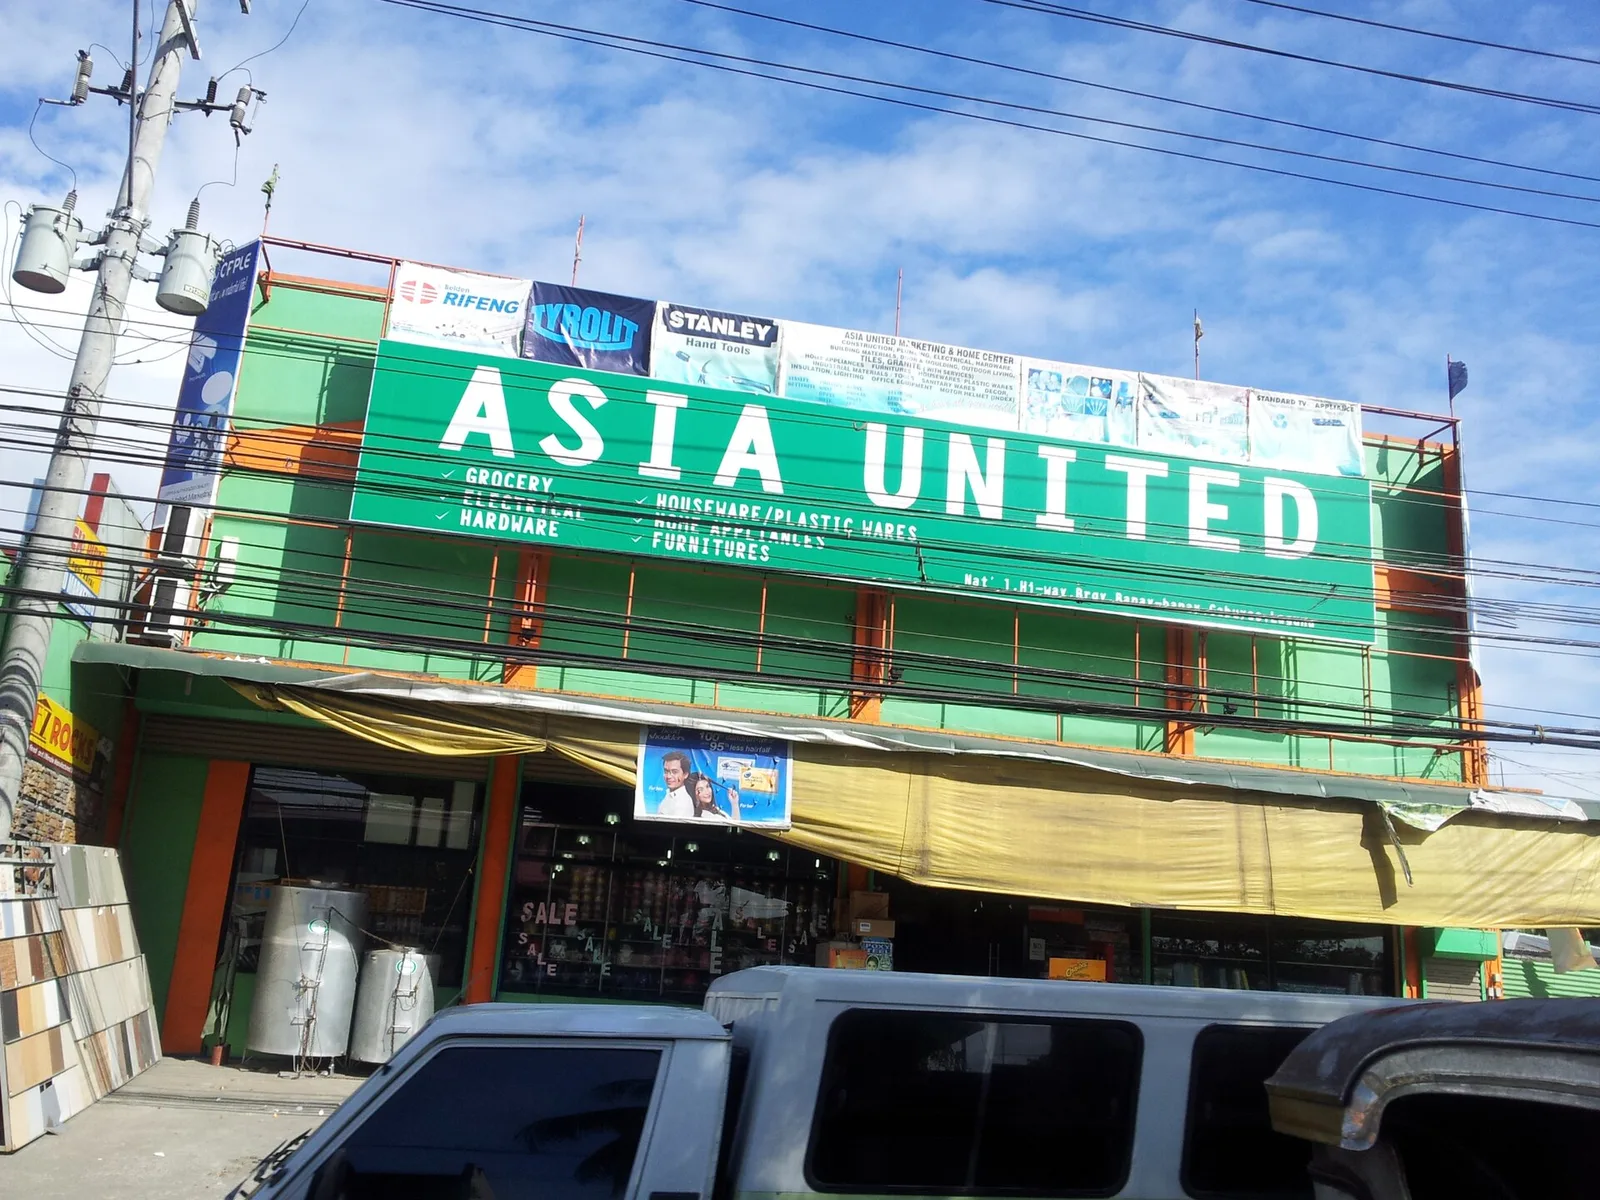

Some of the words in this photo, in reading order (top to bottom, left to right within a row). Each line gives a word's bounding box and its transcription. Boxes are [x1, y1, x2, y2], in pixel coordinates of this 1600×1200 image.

[443, 292, 520, 314] RIFENG
[531, 303, 639, 345] TYROLIT
[668, 311, 772, 342] STANLEY
[685, 336, 716, 351] Hand
[720, 341, 751, 355] Tools
[841, 339, 895, 353] CONSTRUCTION,
[933, 354, 974, 366] ELECTRICAL,
[975, 360, 1013, 371] HARDWARE,
[844, 331, 864, 341] ASIA
[866, 334, 897, 345] UNITED
[898, 339, 946, 354] MRKETING
[948, 347, 954, 355] &
[956, 348, 981, 360] HOME
[982, 353, 1014, 365] CENTER
[830, 344, 860, 354] BUILDING
[961, 365, 992, 375] OUTDOOR
[992, 370, 1015, 379] LIVING,
[861, 355, 885, 366] TILES,
[887, 359, 921, 370] GRANITE
[943, 369, 975, 379] SERVICES)
[790, 363, 832, 375] INSULATION,
[833, 371, 864, 380] LIGHTING
[871, 376, 895, 384] OFFICE
[939, 388, 963, 396] MOTOR
[963, 391, 989, 399] HELMET
[852, 367, 888, 377] MATERIALS
[922, 378, 952, 388] SANITARY
[954, 383, 976, 391] WARES
[964, 378, 990, 388] PLASTIC
[991, 383, 1013, 391] WARES
[1256, 394, 1296, 405] STANDARD
[437, 365, 785, 494] ASIA
[863, 422, 1319, 560] UNITED
[465, 466, 554, 493] GROCERY
[463, 489, 585, 521] ELECTRICAL
[656, 492, 854, 535] HOUSEWARE/PLASTIC
[862, 519, 918, 542] WARES
[460, 508, 560, 538] HARDWARE
[652, 531, 771, 562] FURNITURES
[730, 744, 744, 752] less
[745, 746, 772, 754] hairfall
[520, 902, 578, 925] SALE
[518, 932, 557, 976] SALE
[710, 907, 724, 975] ALE
